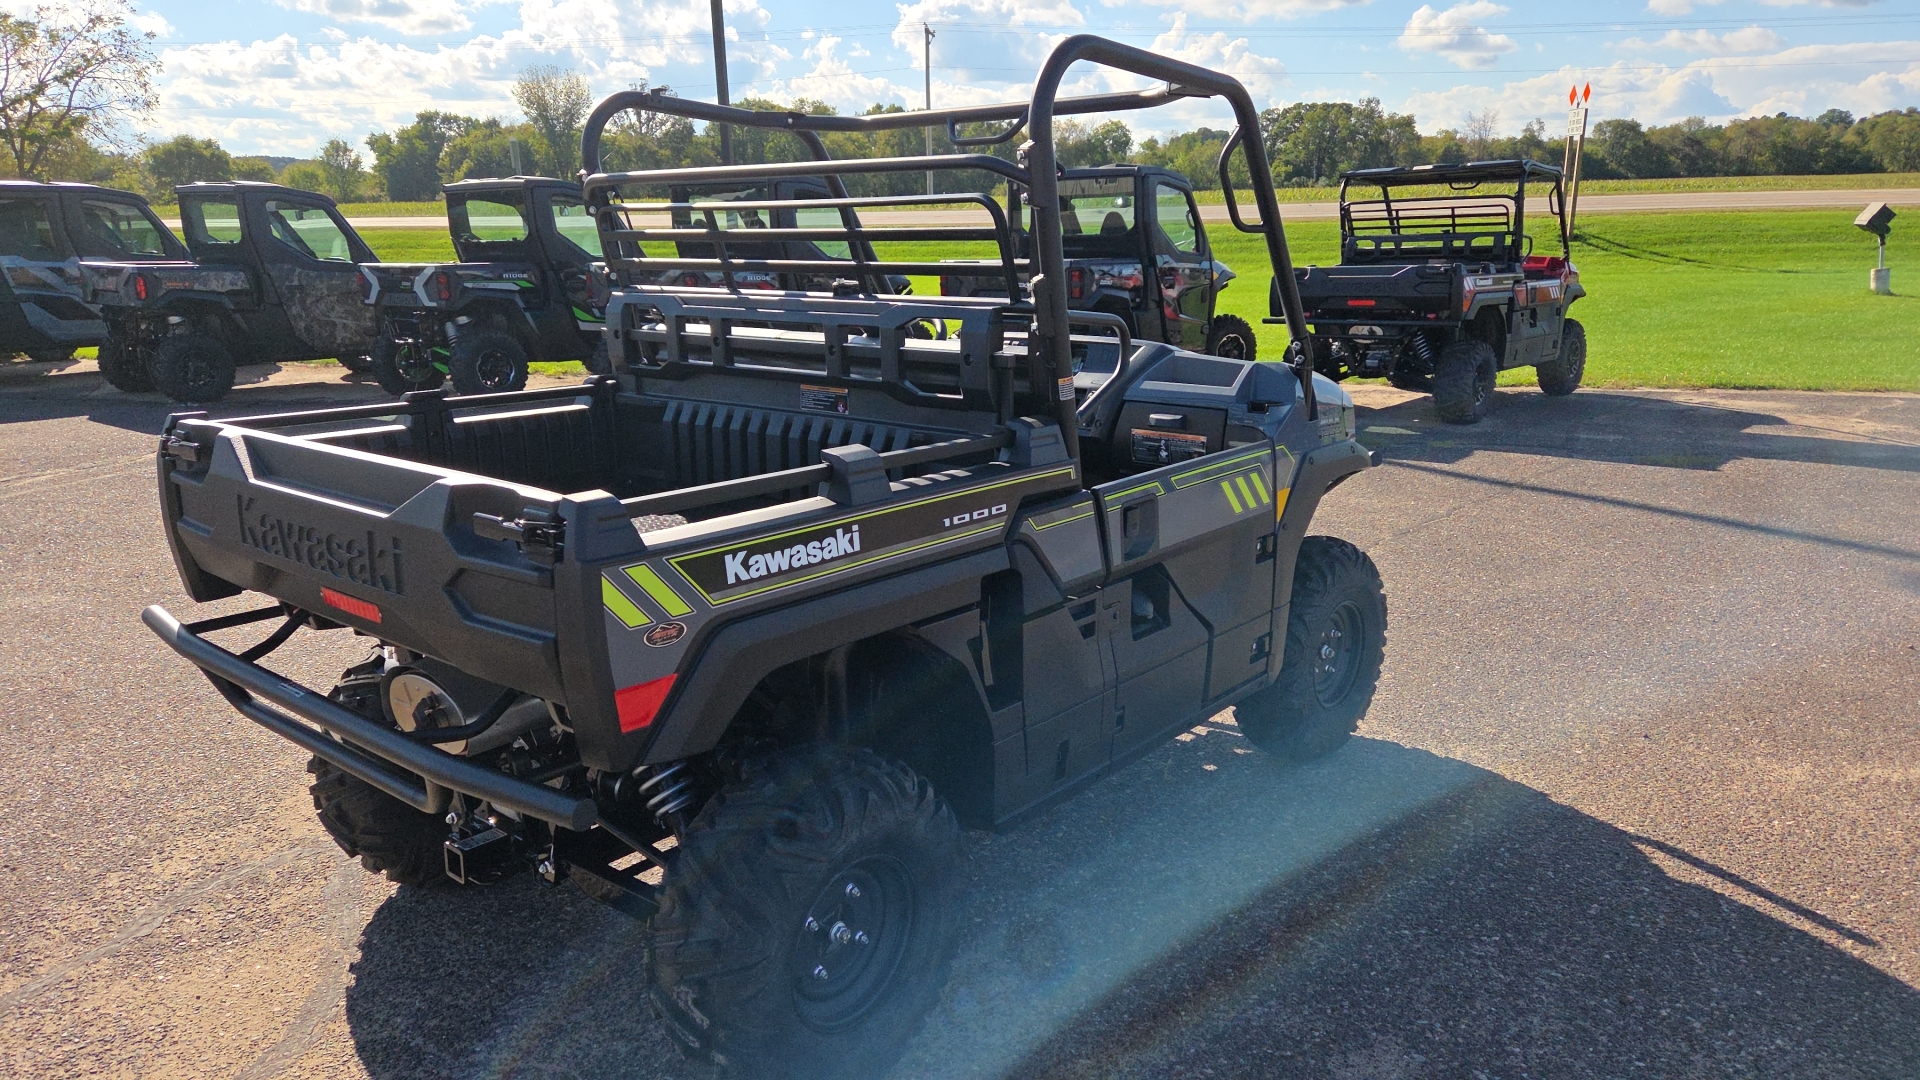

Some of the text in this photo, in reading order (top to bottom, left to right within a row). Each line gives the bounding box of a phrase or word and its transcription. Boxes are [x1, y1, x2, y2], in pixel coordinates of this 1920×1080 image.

[943, 504, 1007, 527] 1000
[237, 494, 405, 597] Kawasaki
[724, 525, 860, 584] Kawasaki
